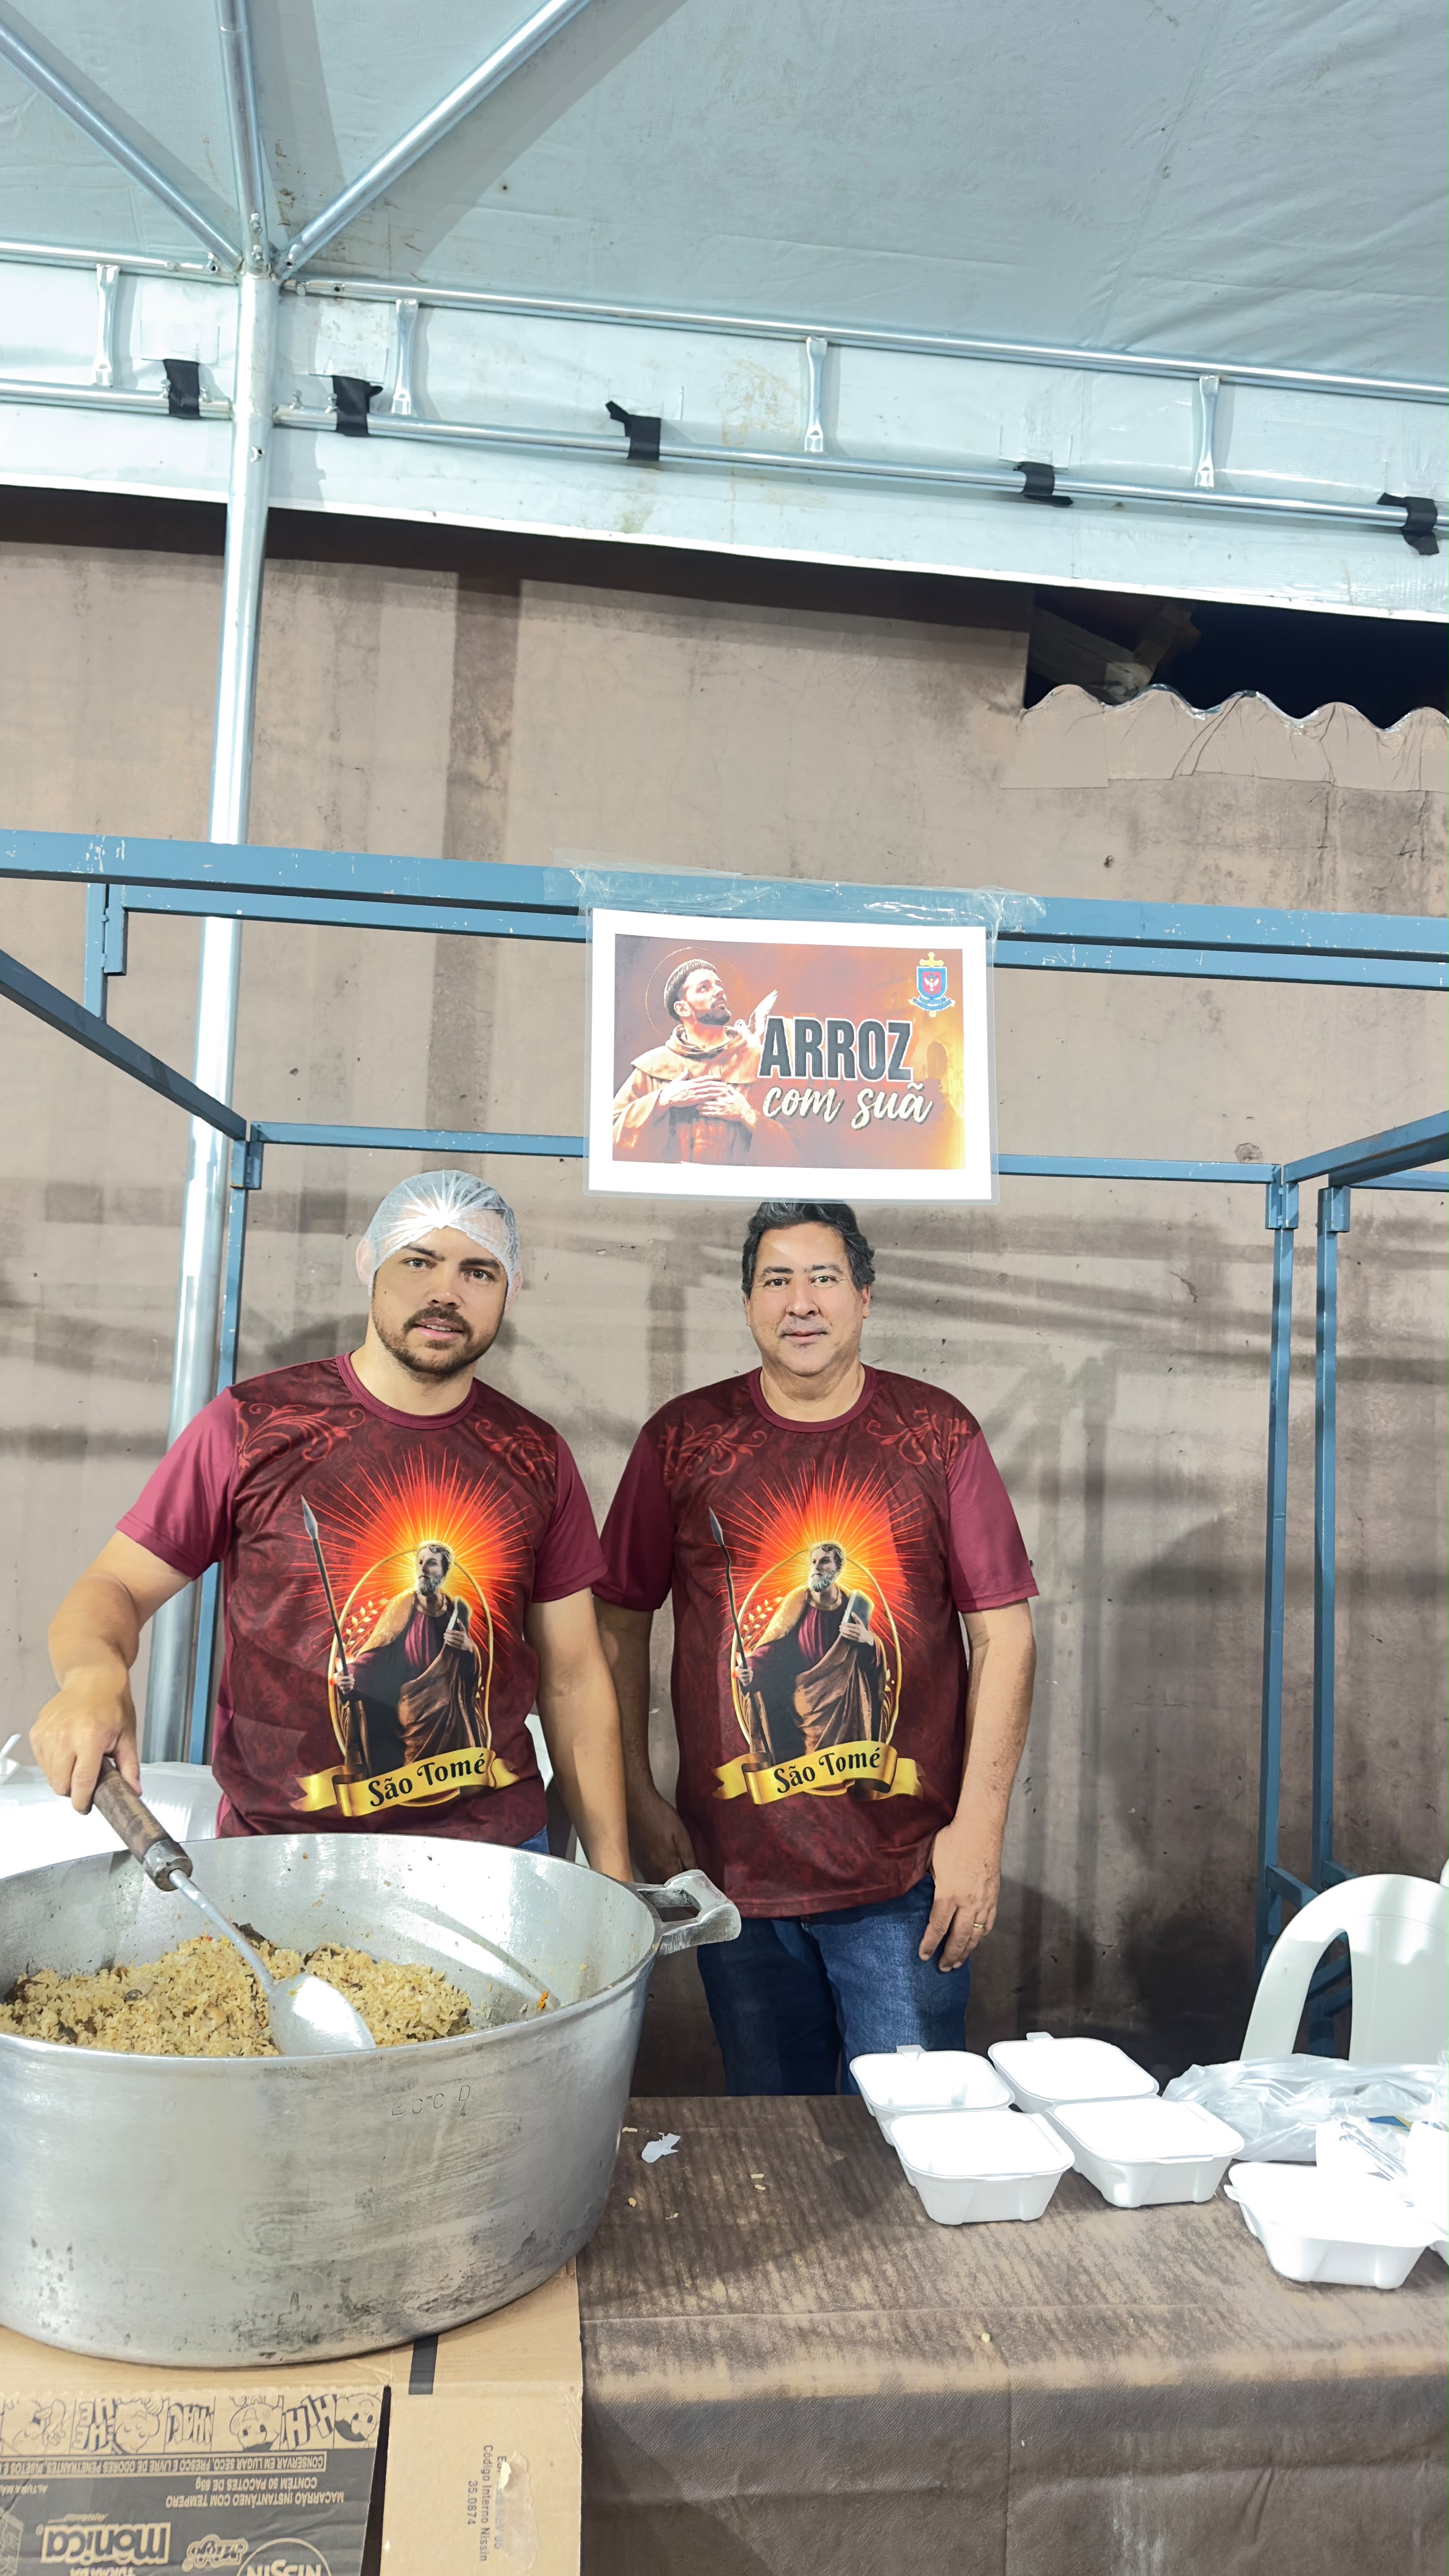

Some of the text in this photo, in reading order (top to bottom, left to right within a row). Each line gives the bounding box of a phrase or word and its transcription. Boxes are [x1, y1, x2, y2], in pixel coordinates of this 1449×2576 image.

[757, 1016, 913, 1082] ARROZ
[762, 1082, 934, 1130] com suã
[773, 1747, 881, 1793] São Tomé
[368, 1753, 485, 1807] São Tomé
[103, 2460, 136, 2473] ODORES
[137, 2460, 147, 2473] DE
[150, 2460, 172, 2472] LIVRE
[180, 2458, 211, 2472] FRESCO
[212, 2457, 235, 2471] SECO,
[237, 2458, 263, 2470] LUGAR
[264, 2457, 275, 2469] EM
[277, 2456, 324, 2469] CONSERVAR
[212, 2478, 225, 2491] DE
[227, 2478, 266, 2491] PACOTES
[268, 2478, 279, 2490] 50
[281, 2477, 317, 2492] CONTÉM
[166, 2491, 344, 2509] MACARRÃO INSTANTÂNEO COM TEMPERO
[467, 2481, 478, 2525] 35.0874
[479, 2445, 494, 2562] Código Interno Nissin
